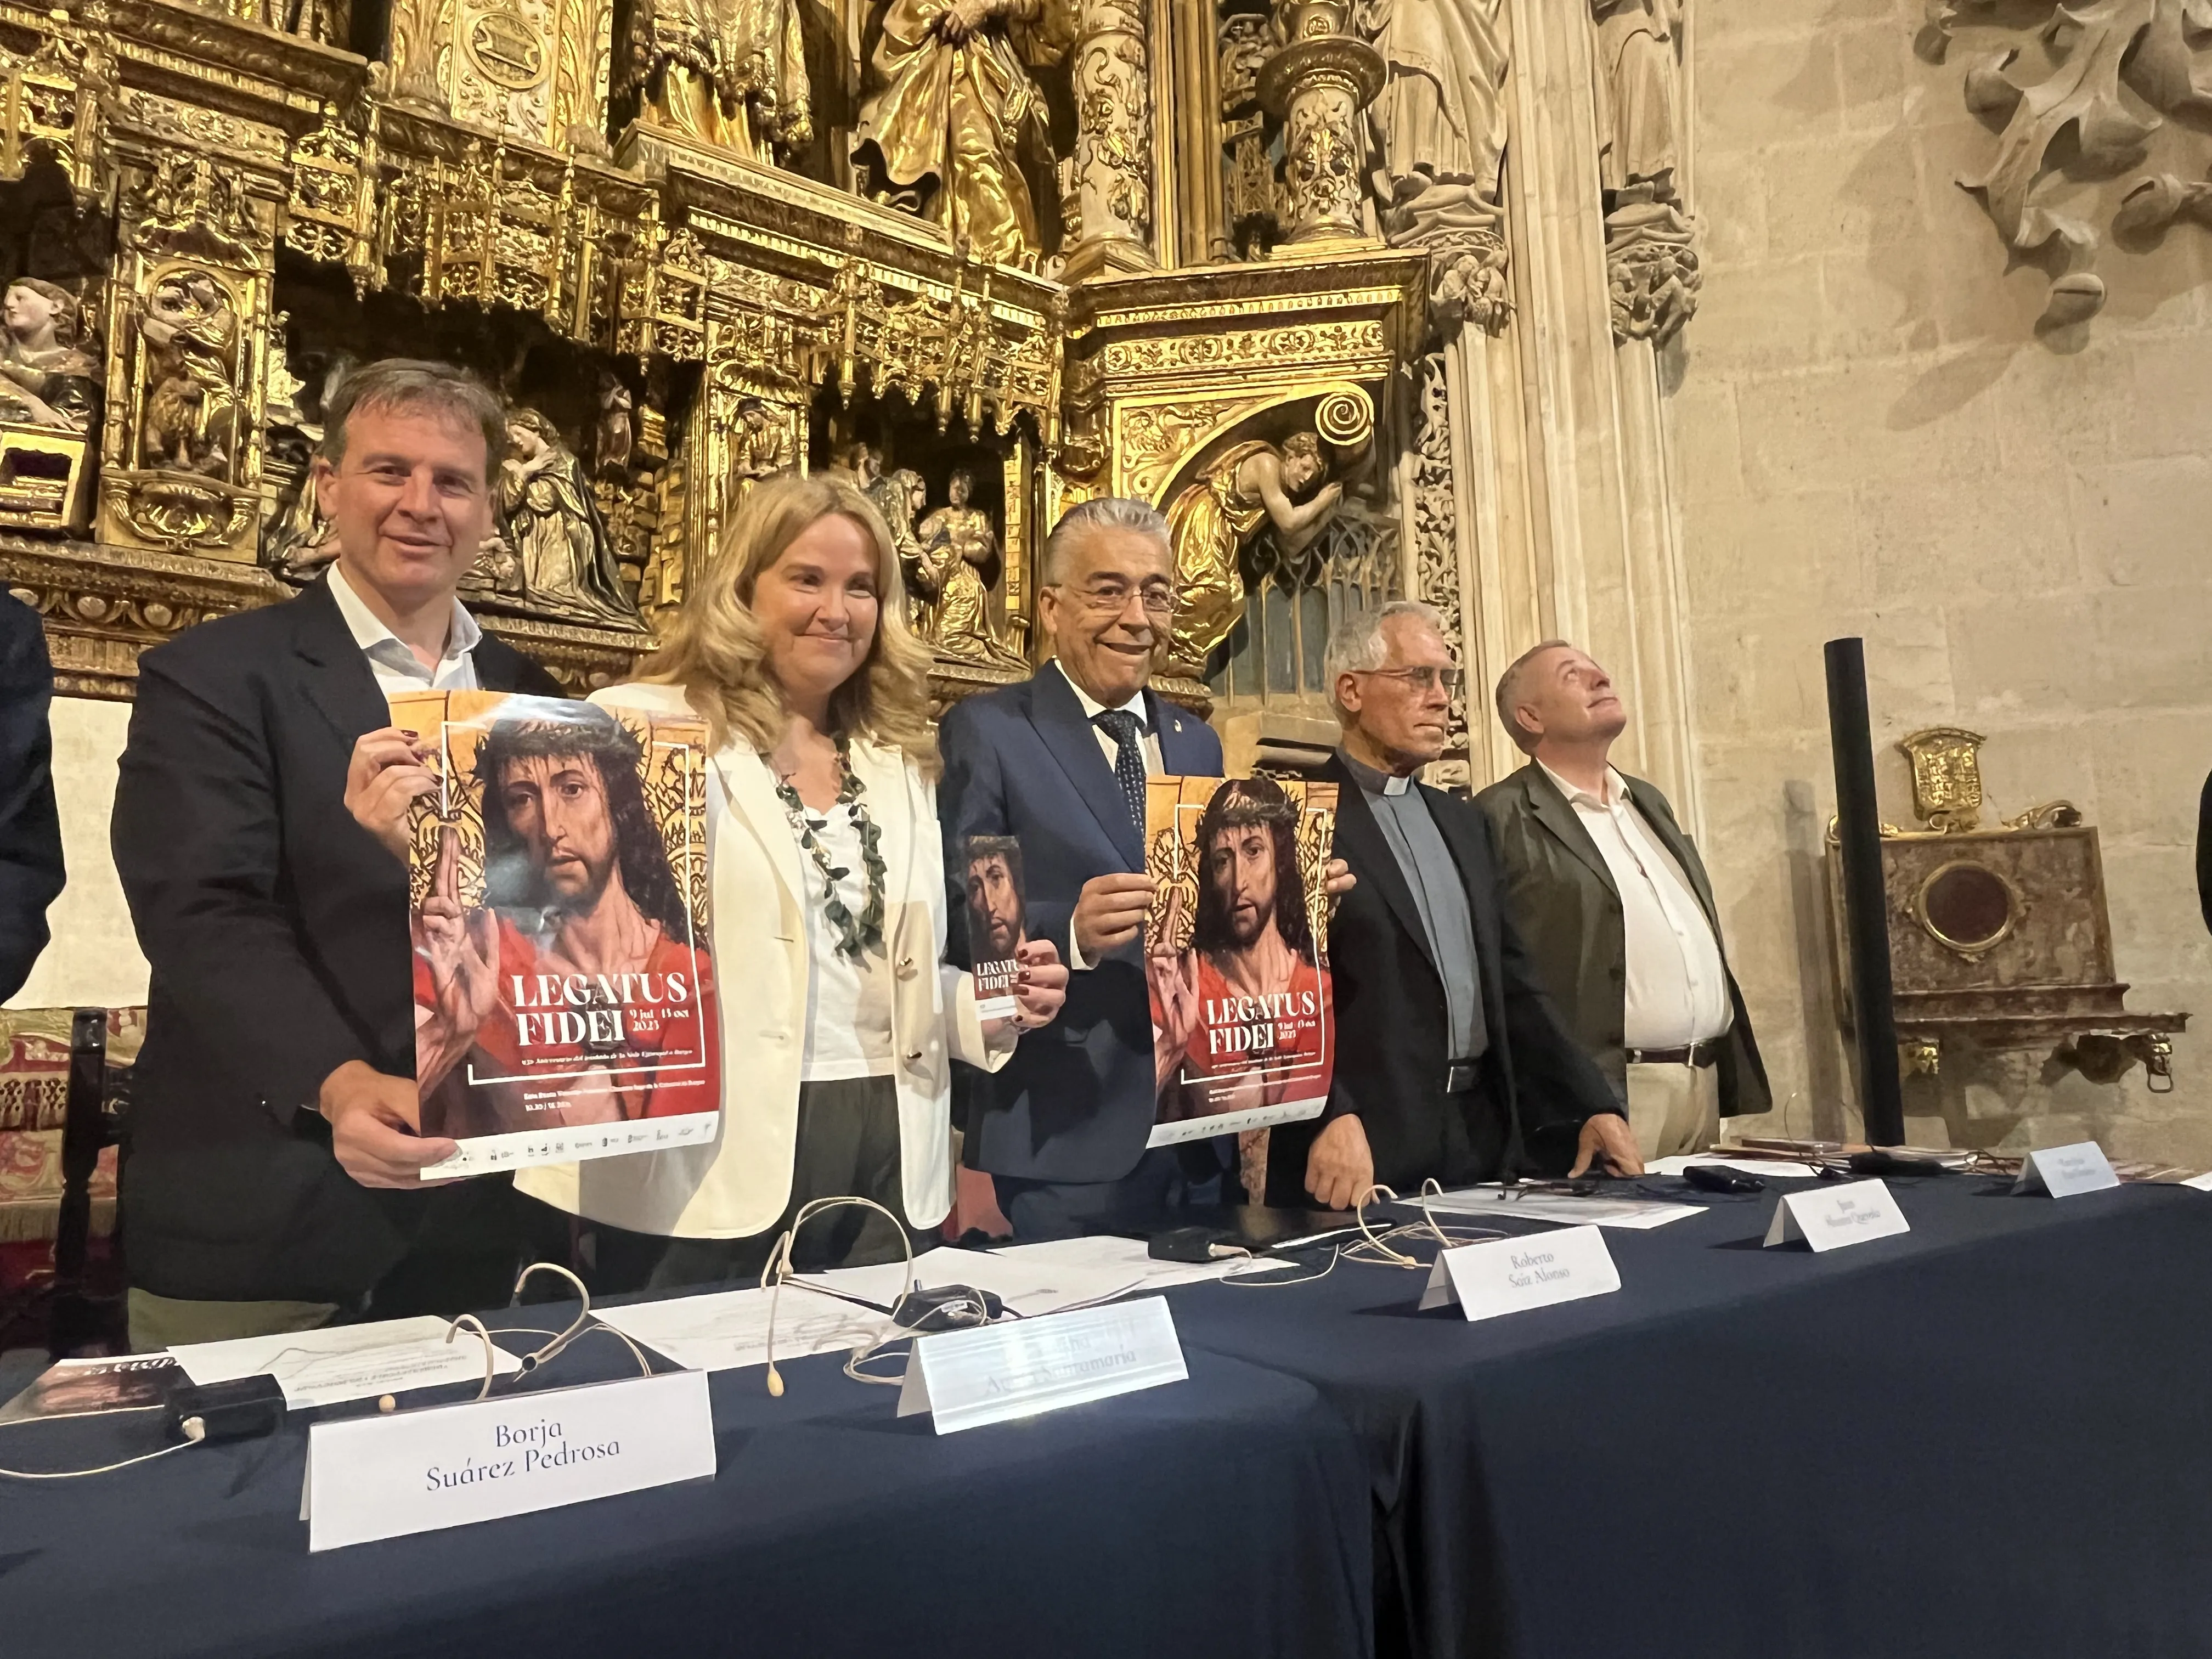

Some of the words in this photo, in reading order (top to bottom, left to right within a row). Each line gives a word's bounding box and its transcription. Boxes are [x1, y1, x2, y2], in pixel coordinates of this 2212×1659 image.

[977, 958, 1019, 976] LEGATU
[510, 972, 687, 1007] LEGATUS
[978, 974, 1009, 992] FIDEI
[639, 1009, 654, 1020] jul
[1206, 990, 1316, 1025] LEGATUS
[516, 1010, 626, 1046] FIDEI
[1209, 1023, 1274, 1054] FIDEI
[1510, 1251, 1554, 1269] Roberto
[496, 1419, 562, 1448] Borja
[427, 1457, 515, 1491] Suárez
[525, 1441, 620, 1472] Pedrosa
